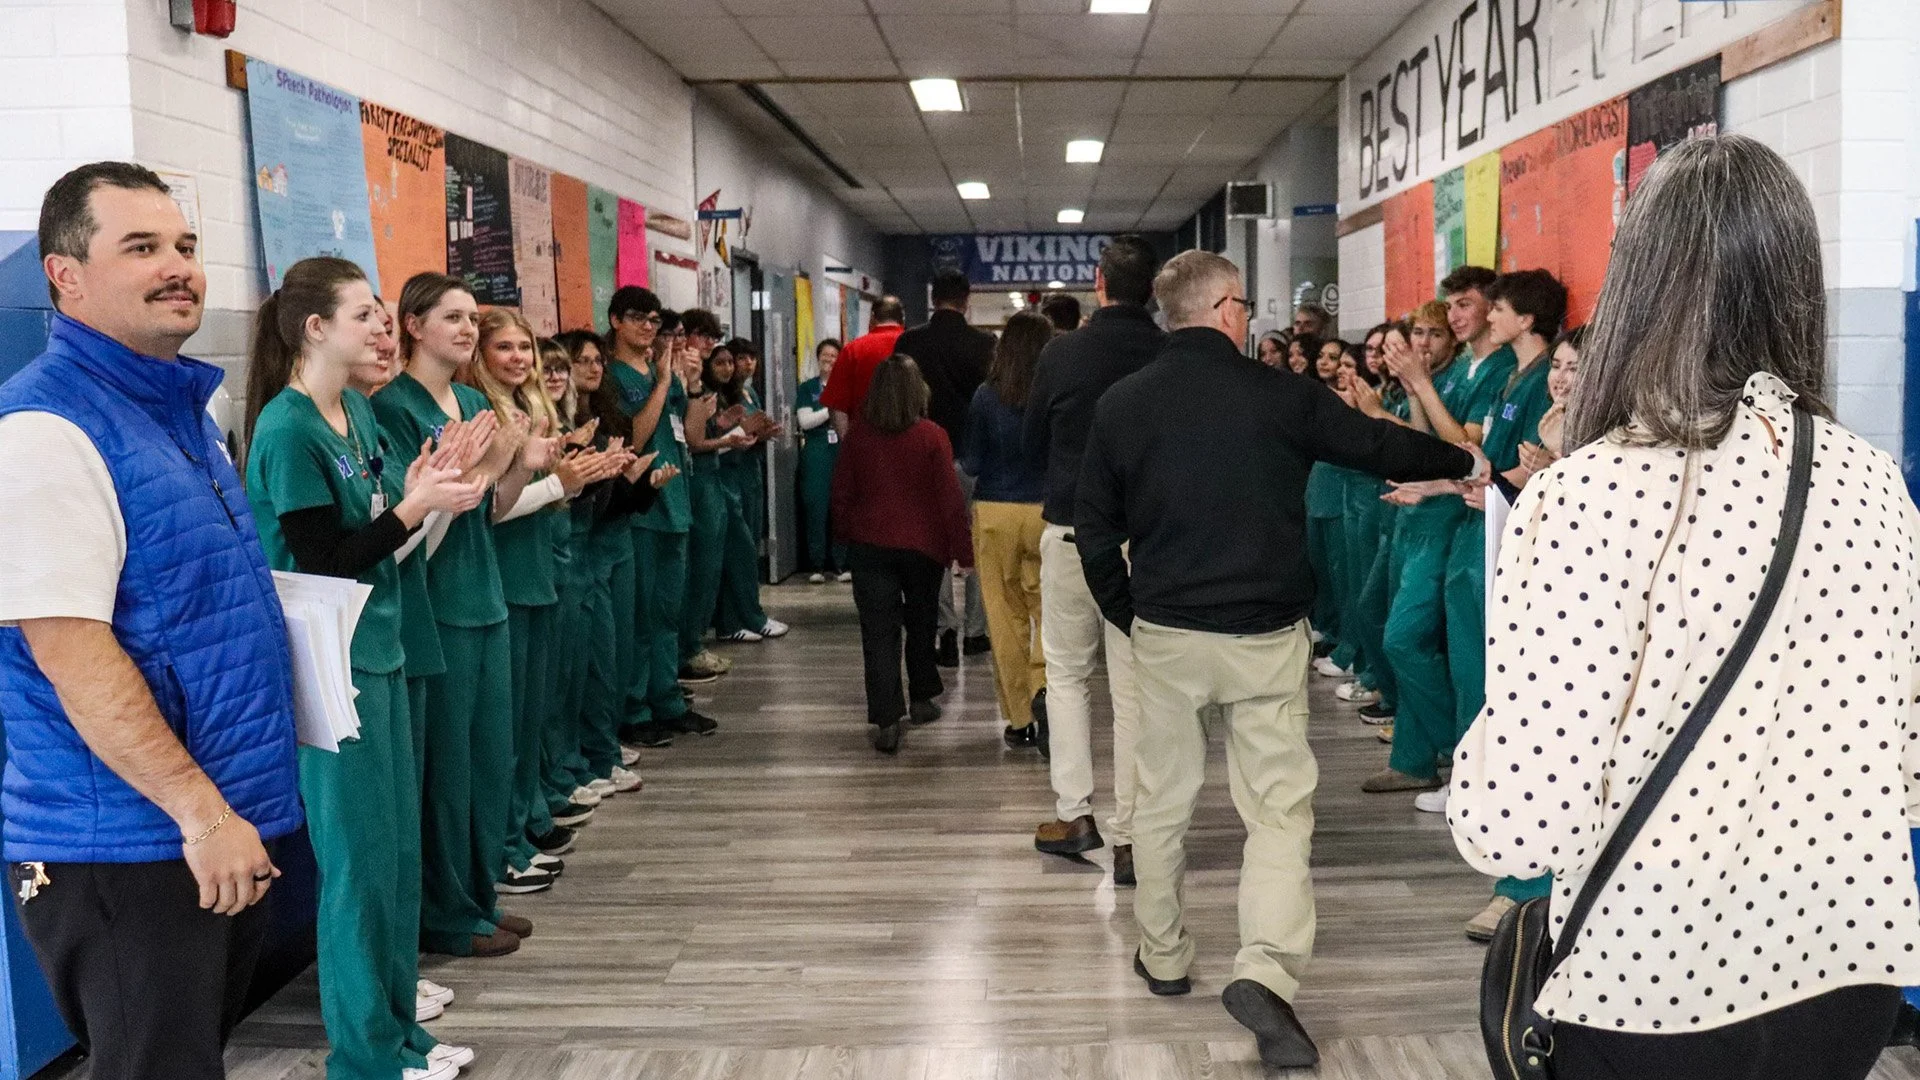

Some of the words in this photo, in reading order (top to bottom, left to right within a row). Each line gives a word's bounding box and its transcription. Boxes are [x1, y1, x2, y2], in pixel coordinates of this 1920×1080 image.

[1360, 46, 1430, 200] BEST
[1434, 0, 1542, 161] YEAR
[359, 101, 393, 134] FOREST
[387, 137, 432, 172] SPECIALIST
[992, 264, 1096, 281] NATION
